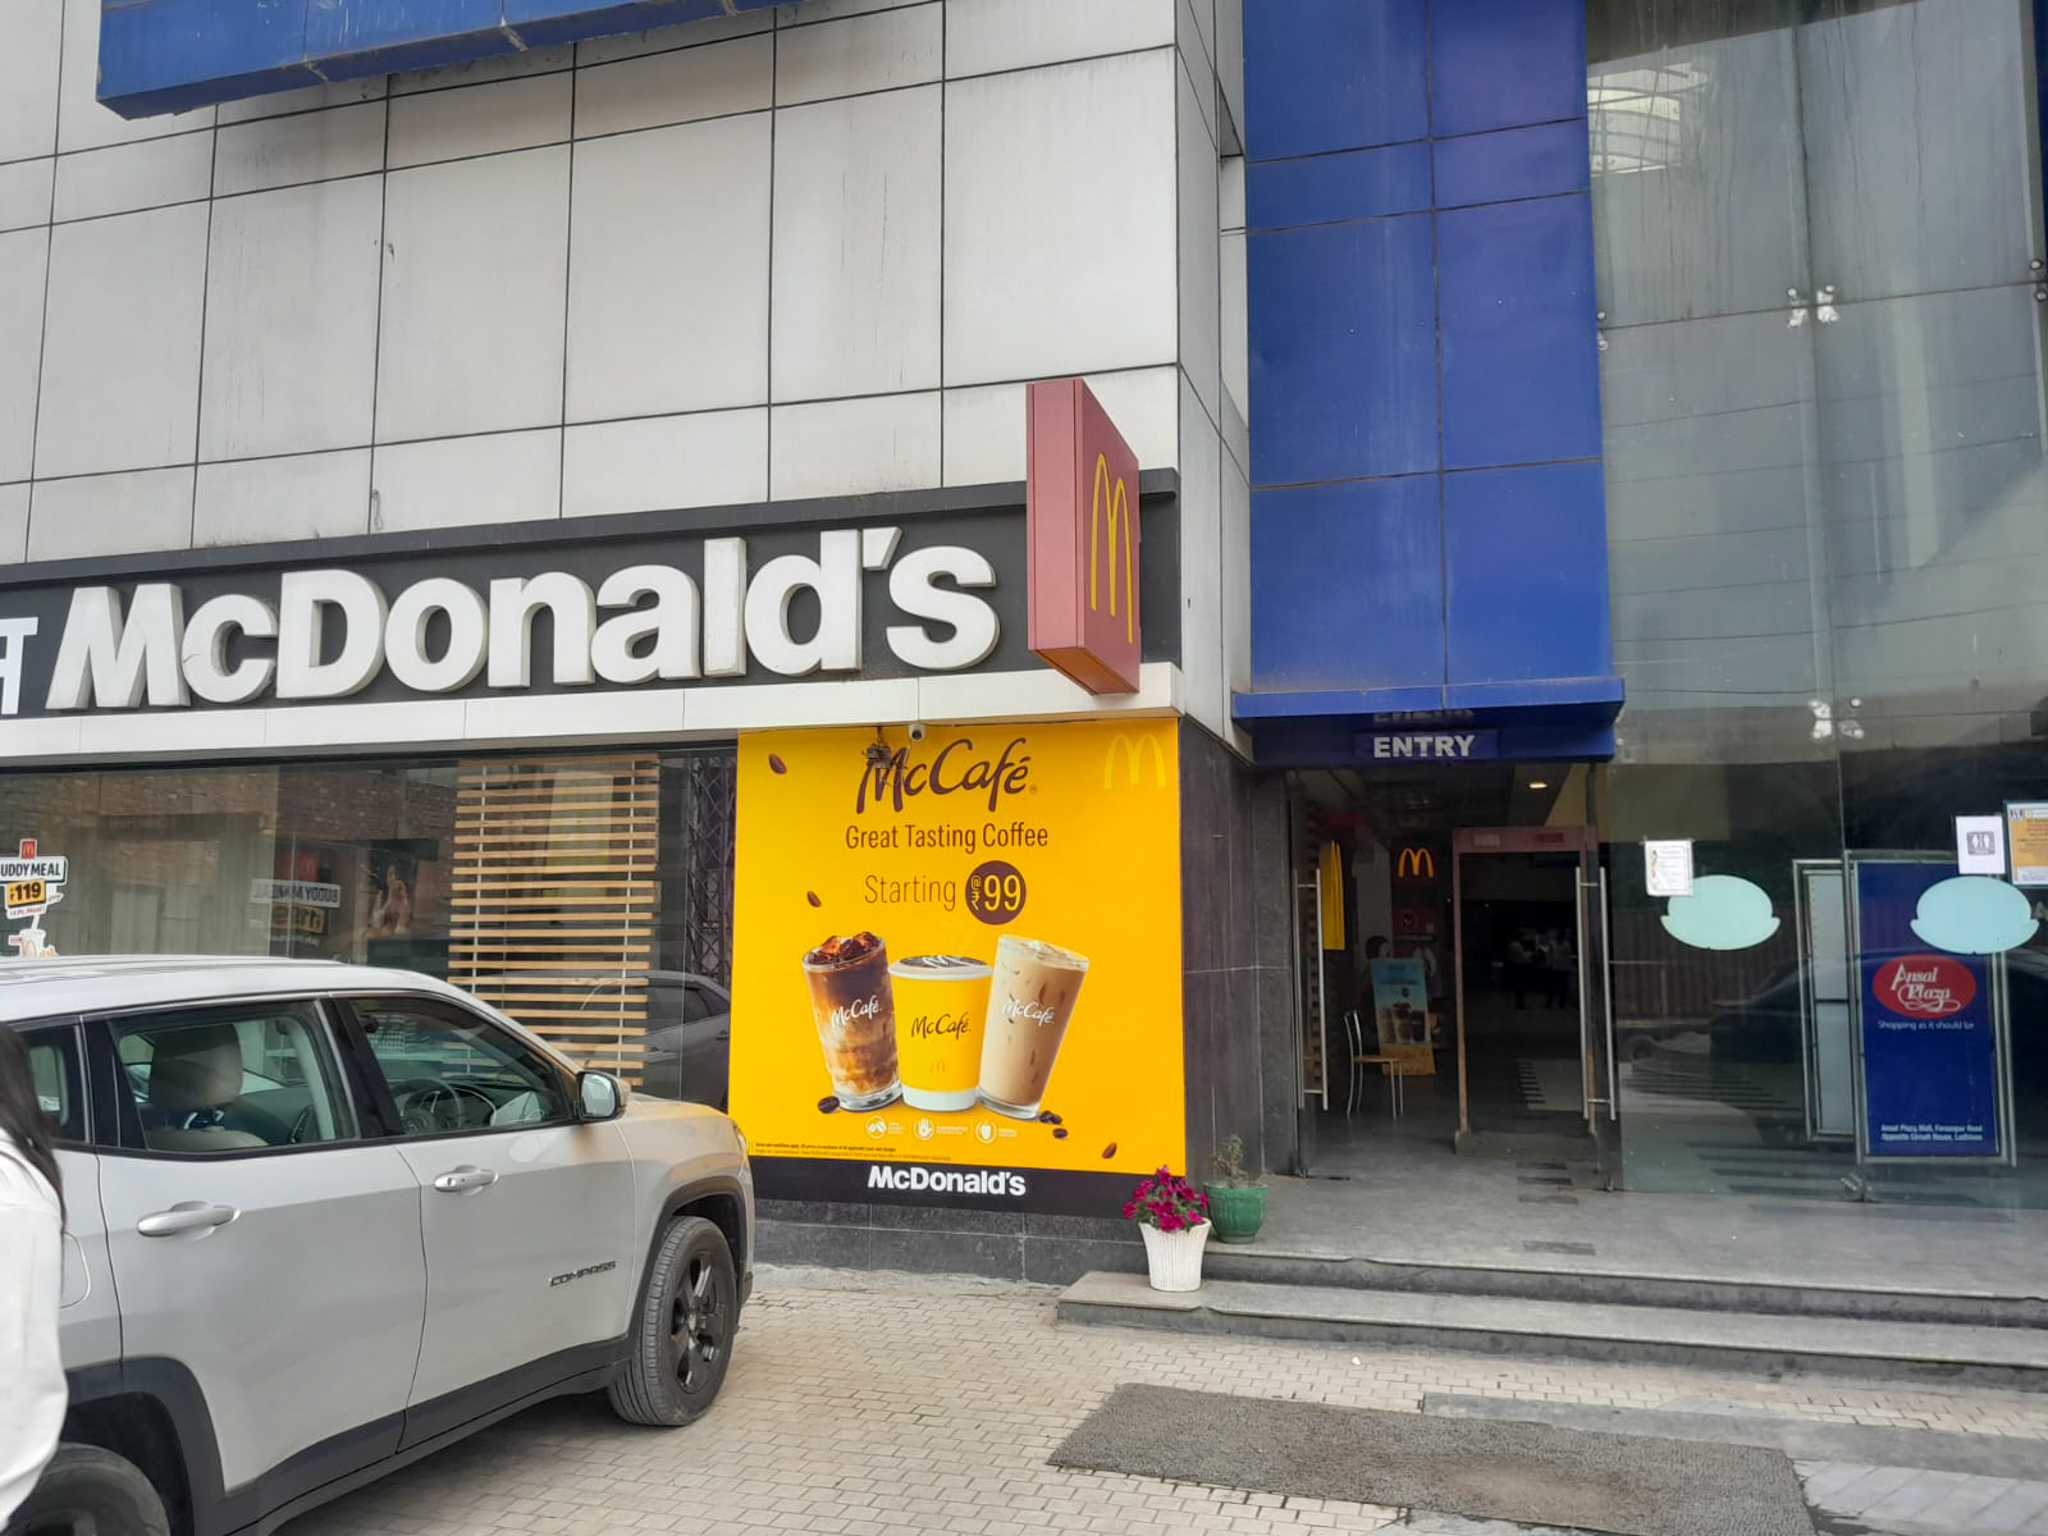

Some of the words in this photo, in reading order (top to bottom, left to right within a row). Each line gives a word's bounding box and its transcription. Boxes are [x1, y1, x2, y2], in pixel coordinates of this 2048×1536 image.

[45, 527, 999, 711] McDonald's
[1373, 735, 1475, 759] ENTRY
[856, 737, 1032, 815] McCafé
[845, 825, 899, 849] Great
[905, 824, 976, 854] Tasting
[982, 821, 1049, 848] Coffee
[0, 863, 29, 877] UDDY
[30, 862, 61, 876] MEAL
[864, 875, 956, 912] Starting
[831, 994, 880, 1029] McCafé
[910, 1012, 970, 1040] McCafé
[1001, 999, 1056, 1027] McCafé
[867, 1165, 1027, 1196] McDonald's
[550, 1261, 617, 1287] COMPASS
